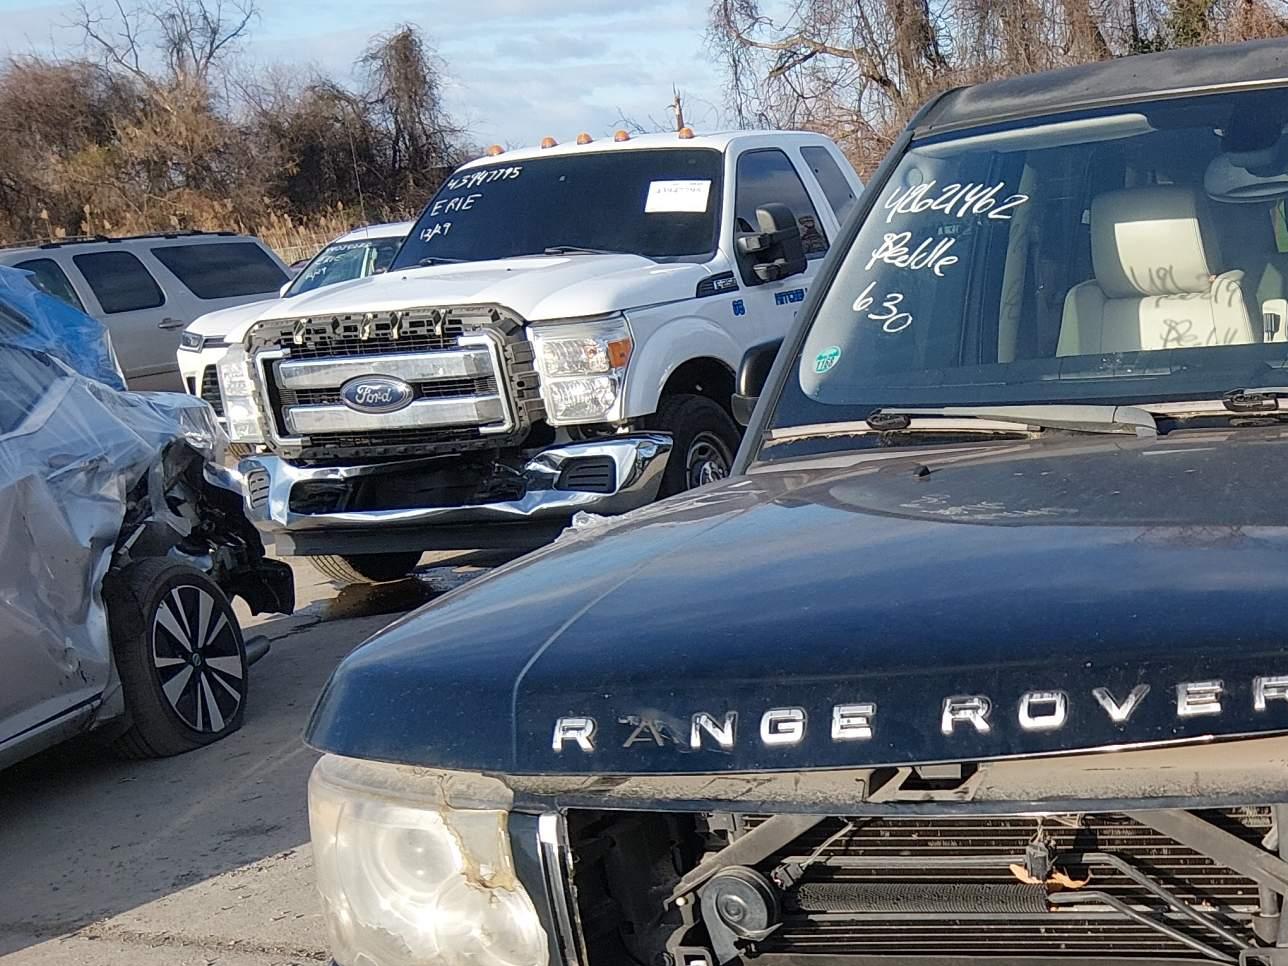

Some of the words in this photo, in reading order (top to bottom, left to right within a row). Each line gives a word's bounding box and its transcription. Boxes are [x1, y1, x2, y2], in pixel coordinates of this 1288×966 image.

[430, 193, 482, 217] ERIE
[355, 384, 393, 404] Ford
[552, 703, 877, 752] RANGE
